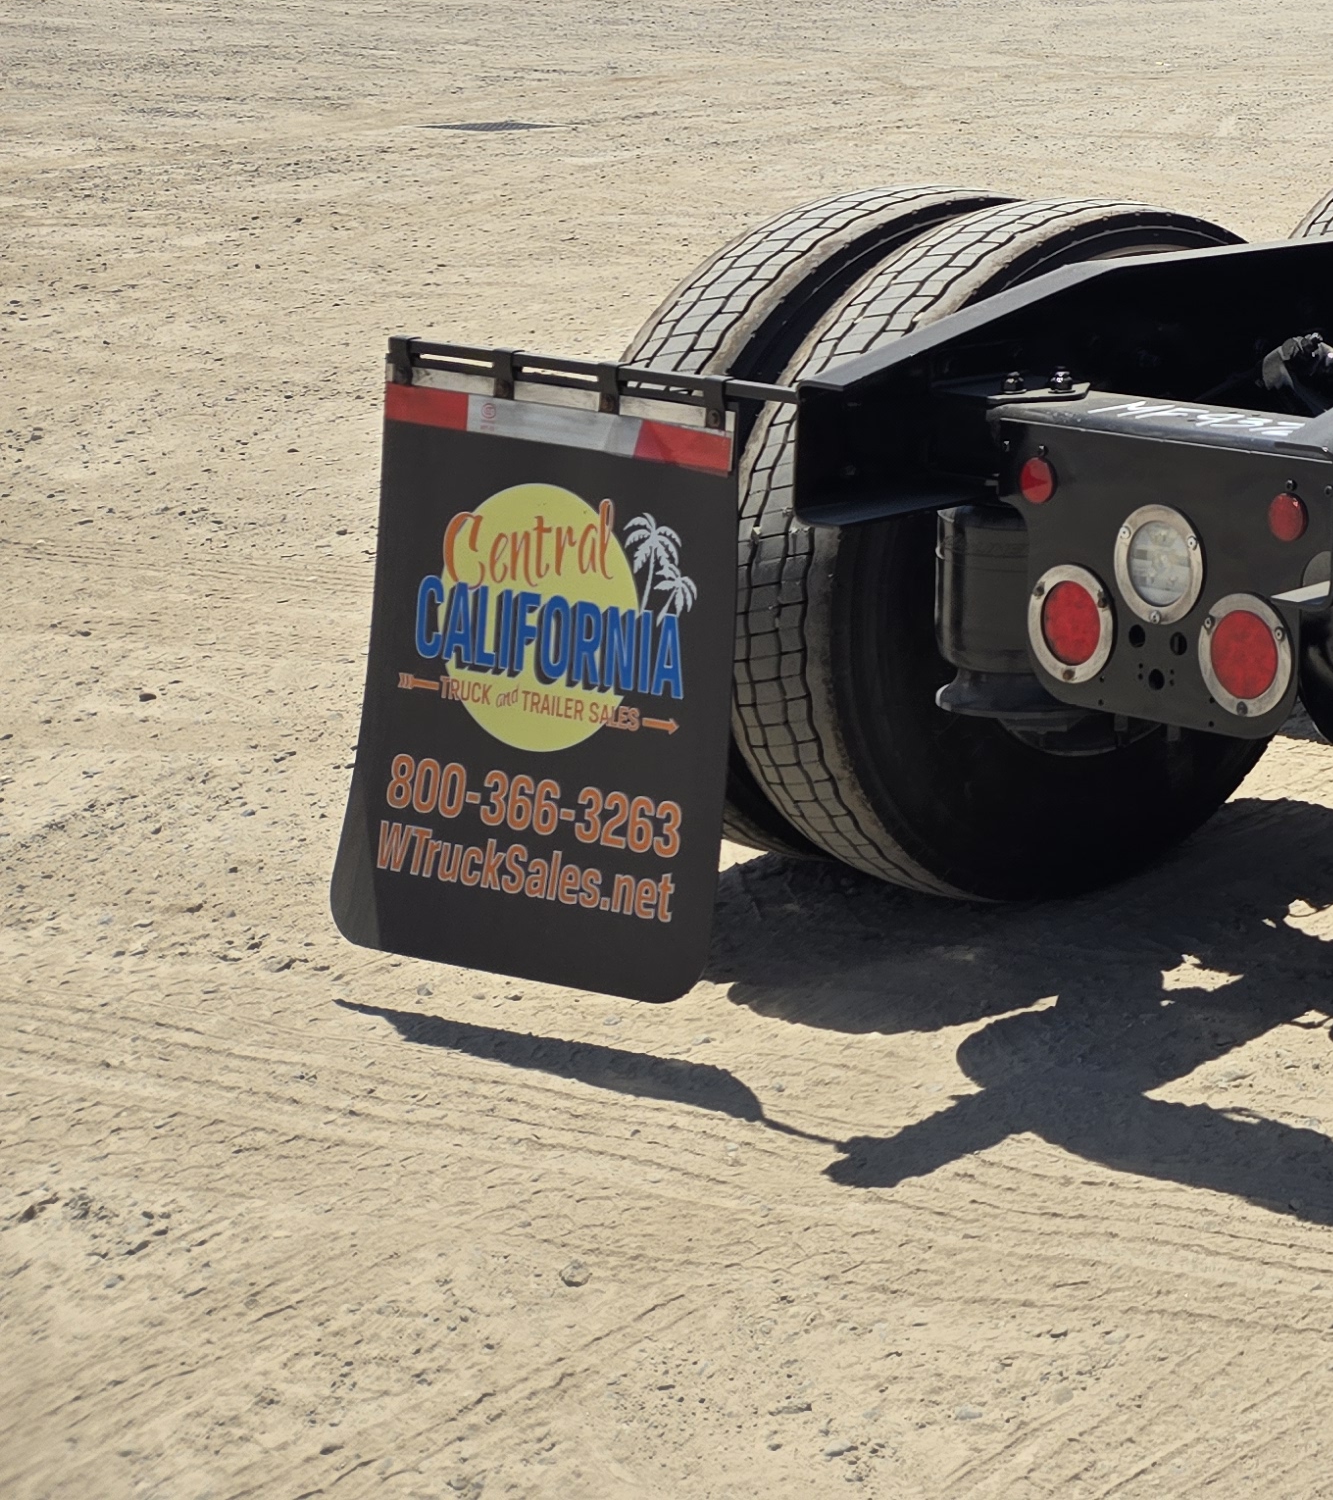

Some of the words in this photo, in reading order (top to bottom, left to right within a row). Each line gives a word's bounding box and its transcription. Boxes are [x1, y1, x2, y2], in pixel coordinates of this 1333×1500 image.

[443, 497, 615, 591] Central
[415, 573, 684, 700] CALIFORNIA
[439, 674, 491, 707] TRUCK
[495, 682, 519, 710] and
[521, 688, 584, 723] TRAILER
[589, 702, 640, 733] SALES
[386, 752, 681, 858] 800-366-3263
[376, 819, 674, 922] WTruckSales.net
